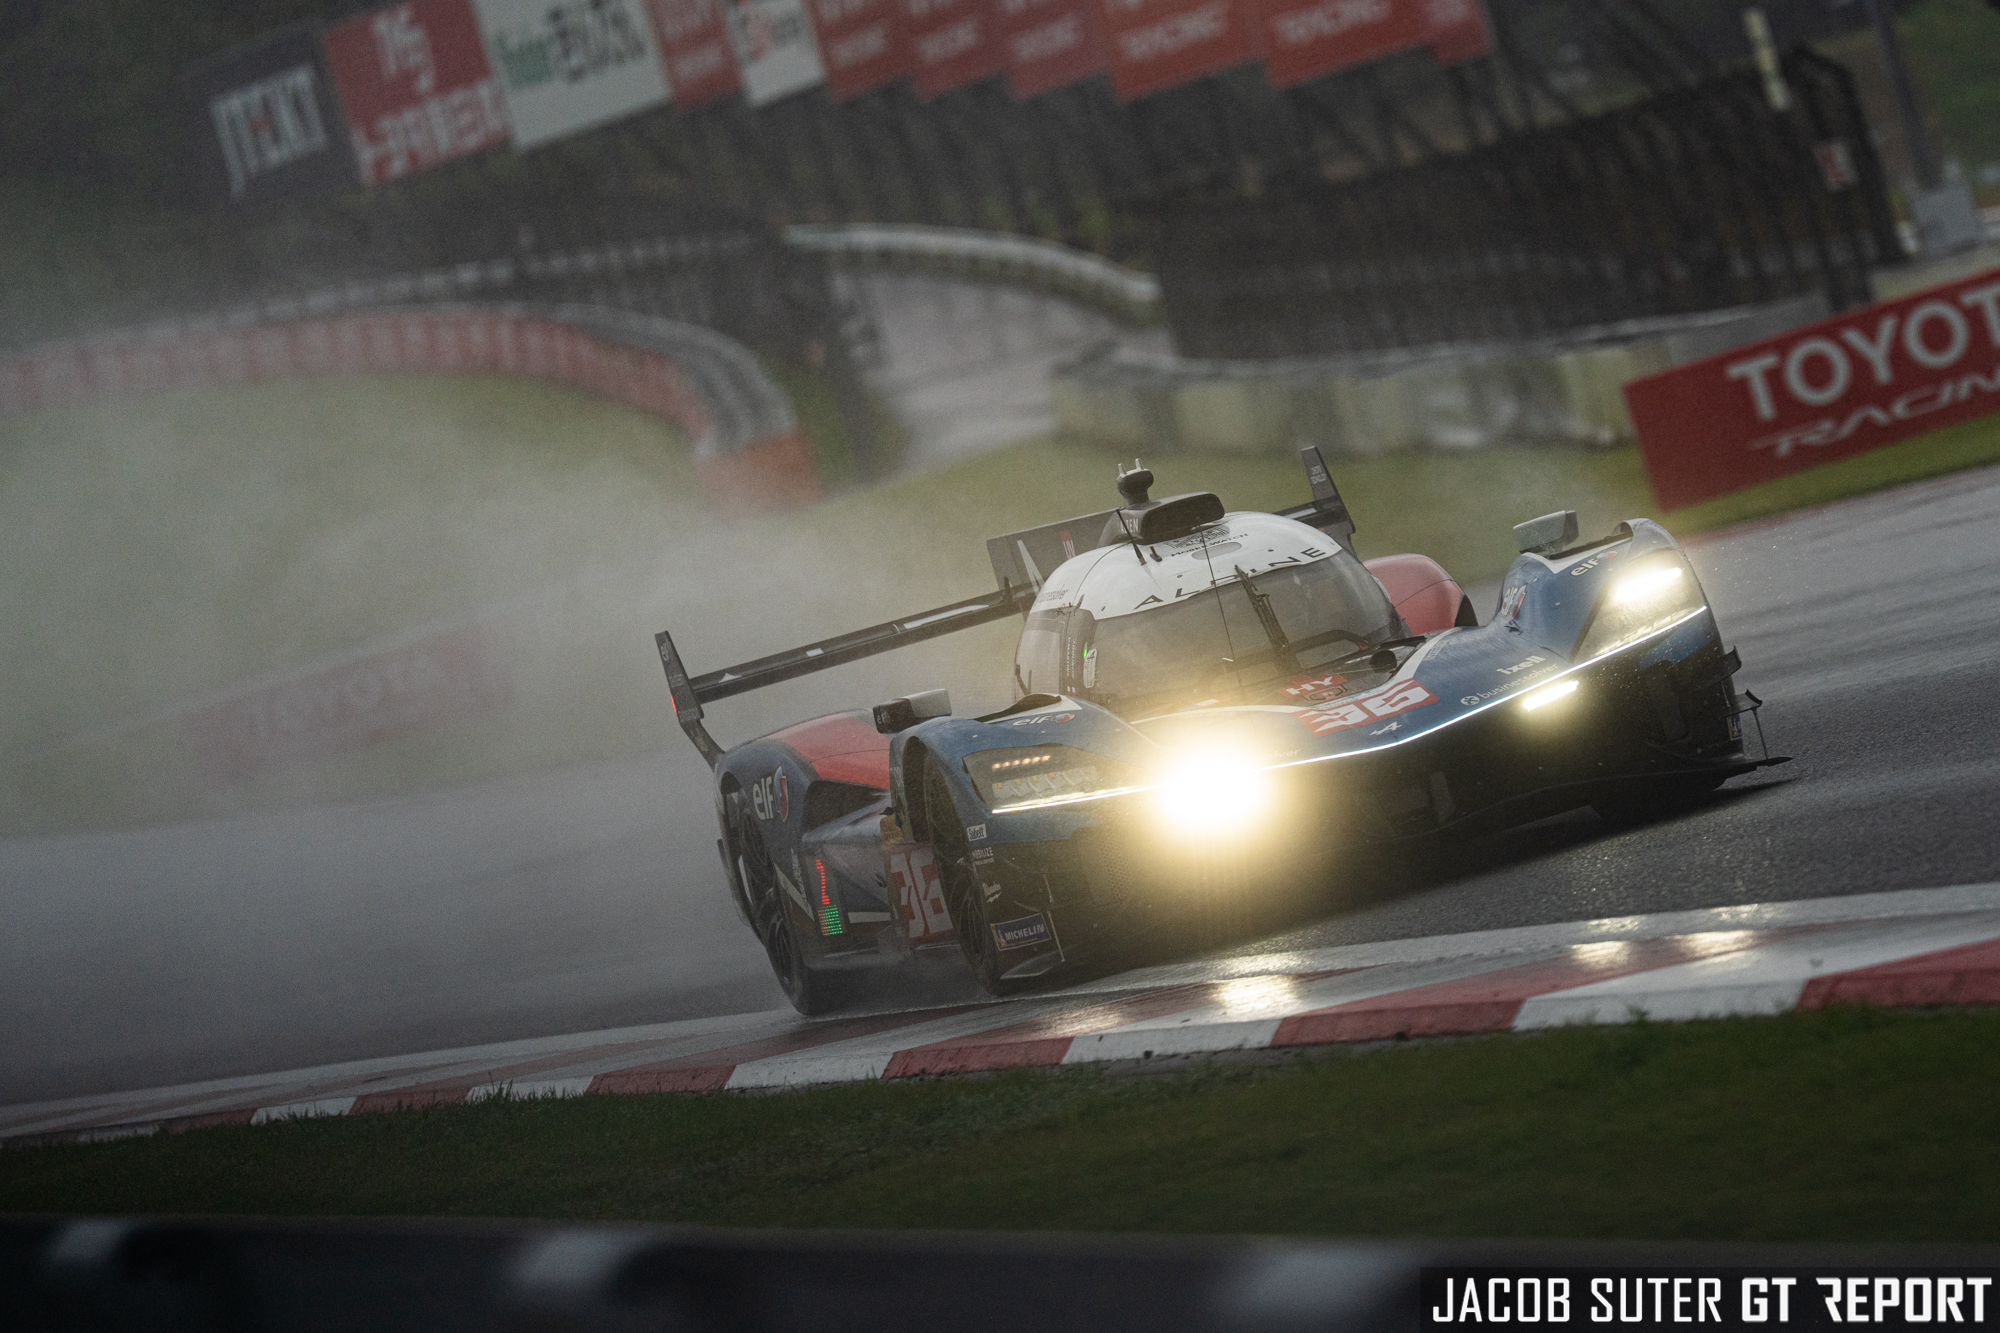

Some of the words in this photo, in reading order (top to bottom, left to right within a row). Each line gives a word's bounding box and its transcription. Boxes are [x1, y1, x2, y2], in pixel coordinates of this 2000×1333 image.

[1571, 558, 1599, 576] elf
[1496, 656, 1545, 674] ixell
[1286, 676, 1334, 695] HY
[1477, 662, 1559, 699] businessolver
[1299, 680, 1430, 733] 36
[1013, 715, 1053, 726] elf
[753, 776, 774, 820] elf
[1004, 924, 1045, 941] MICHELIN
